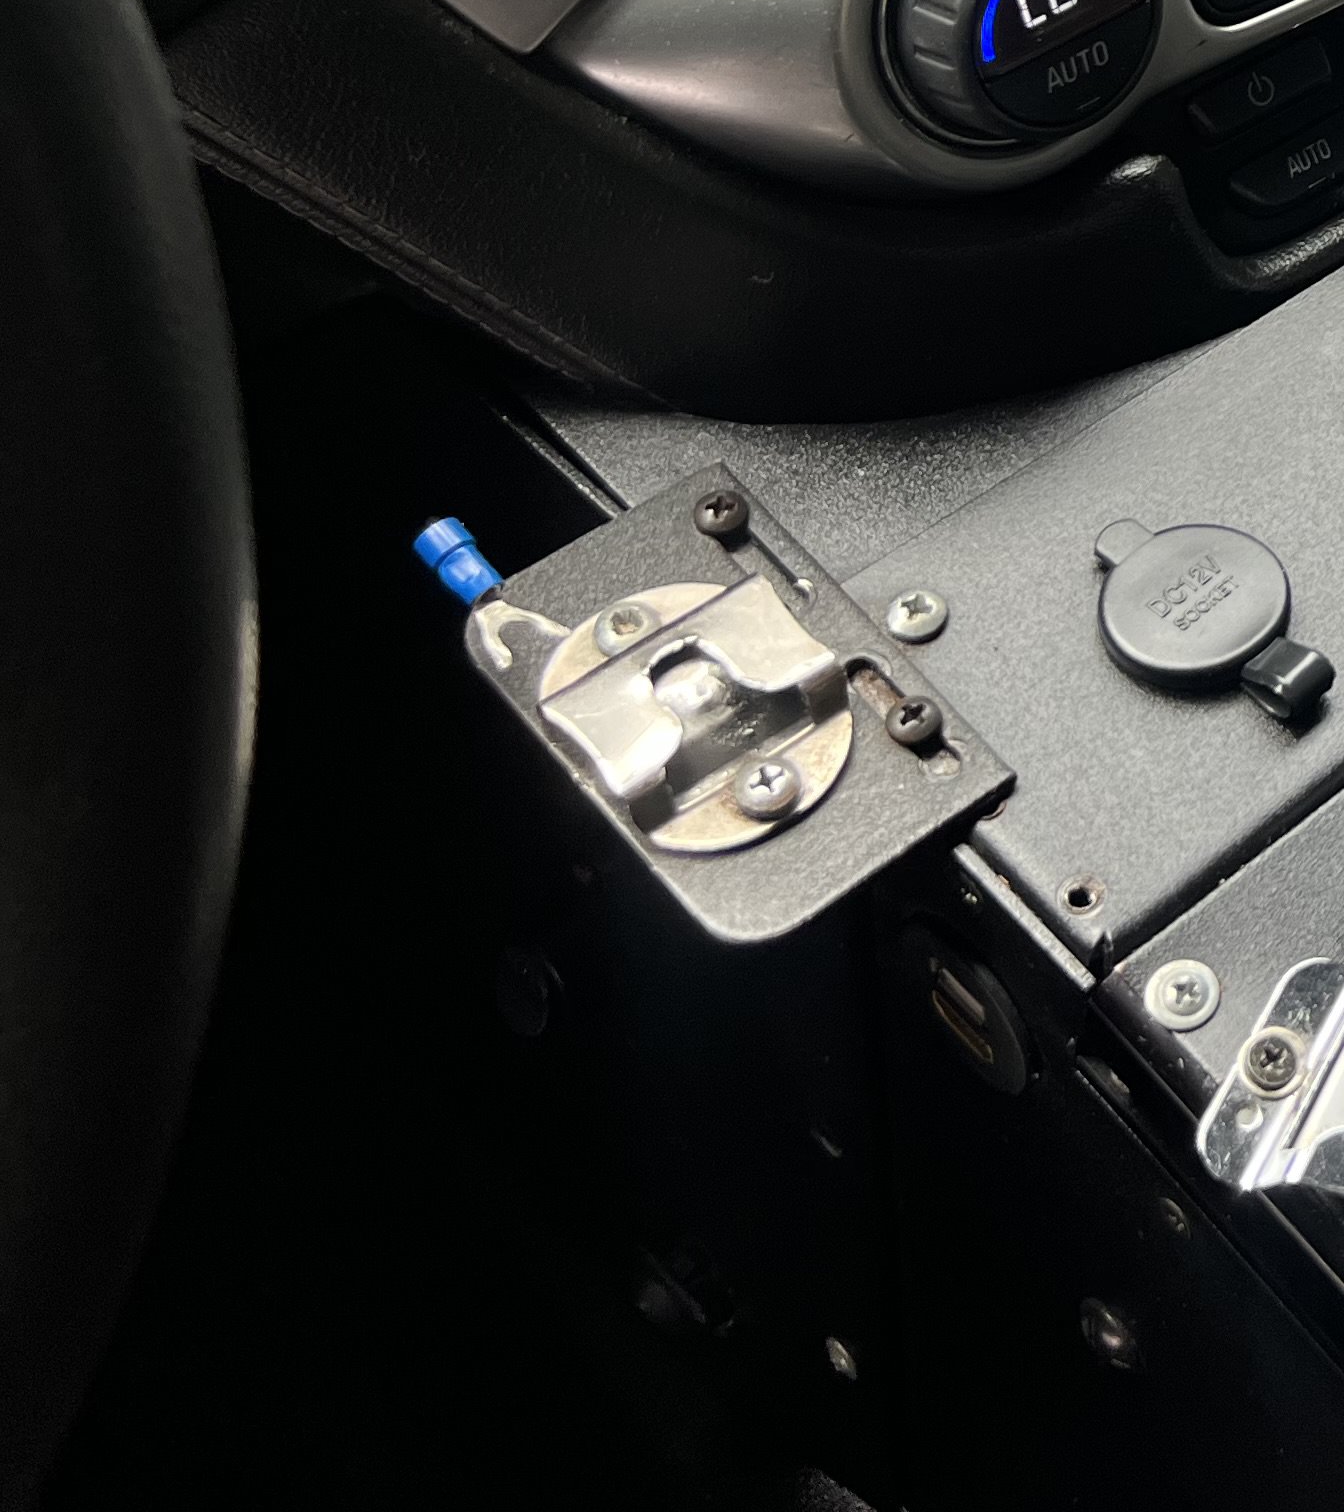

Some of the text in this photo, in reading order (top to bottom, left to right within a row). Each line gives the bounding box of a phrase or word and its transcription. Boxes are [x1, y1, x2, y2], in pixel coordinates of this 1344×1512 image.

[1047, 40, 1110, 94] AUTO
[1287, 137, 1332, 180] AUTO
[1145, 554, 1222, 619] DC12V
[1173, 575, 1240, 631] SOCKET
